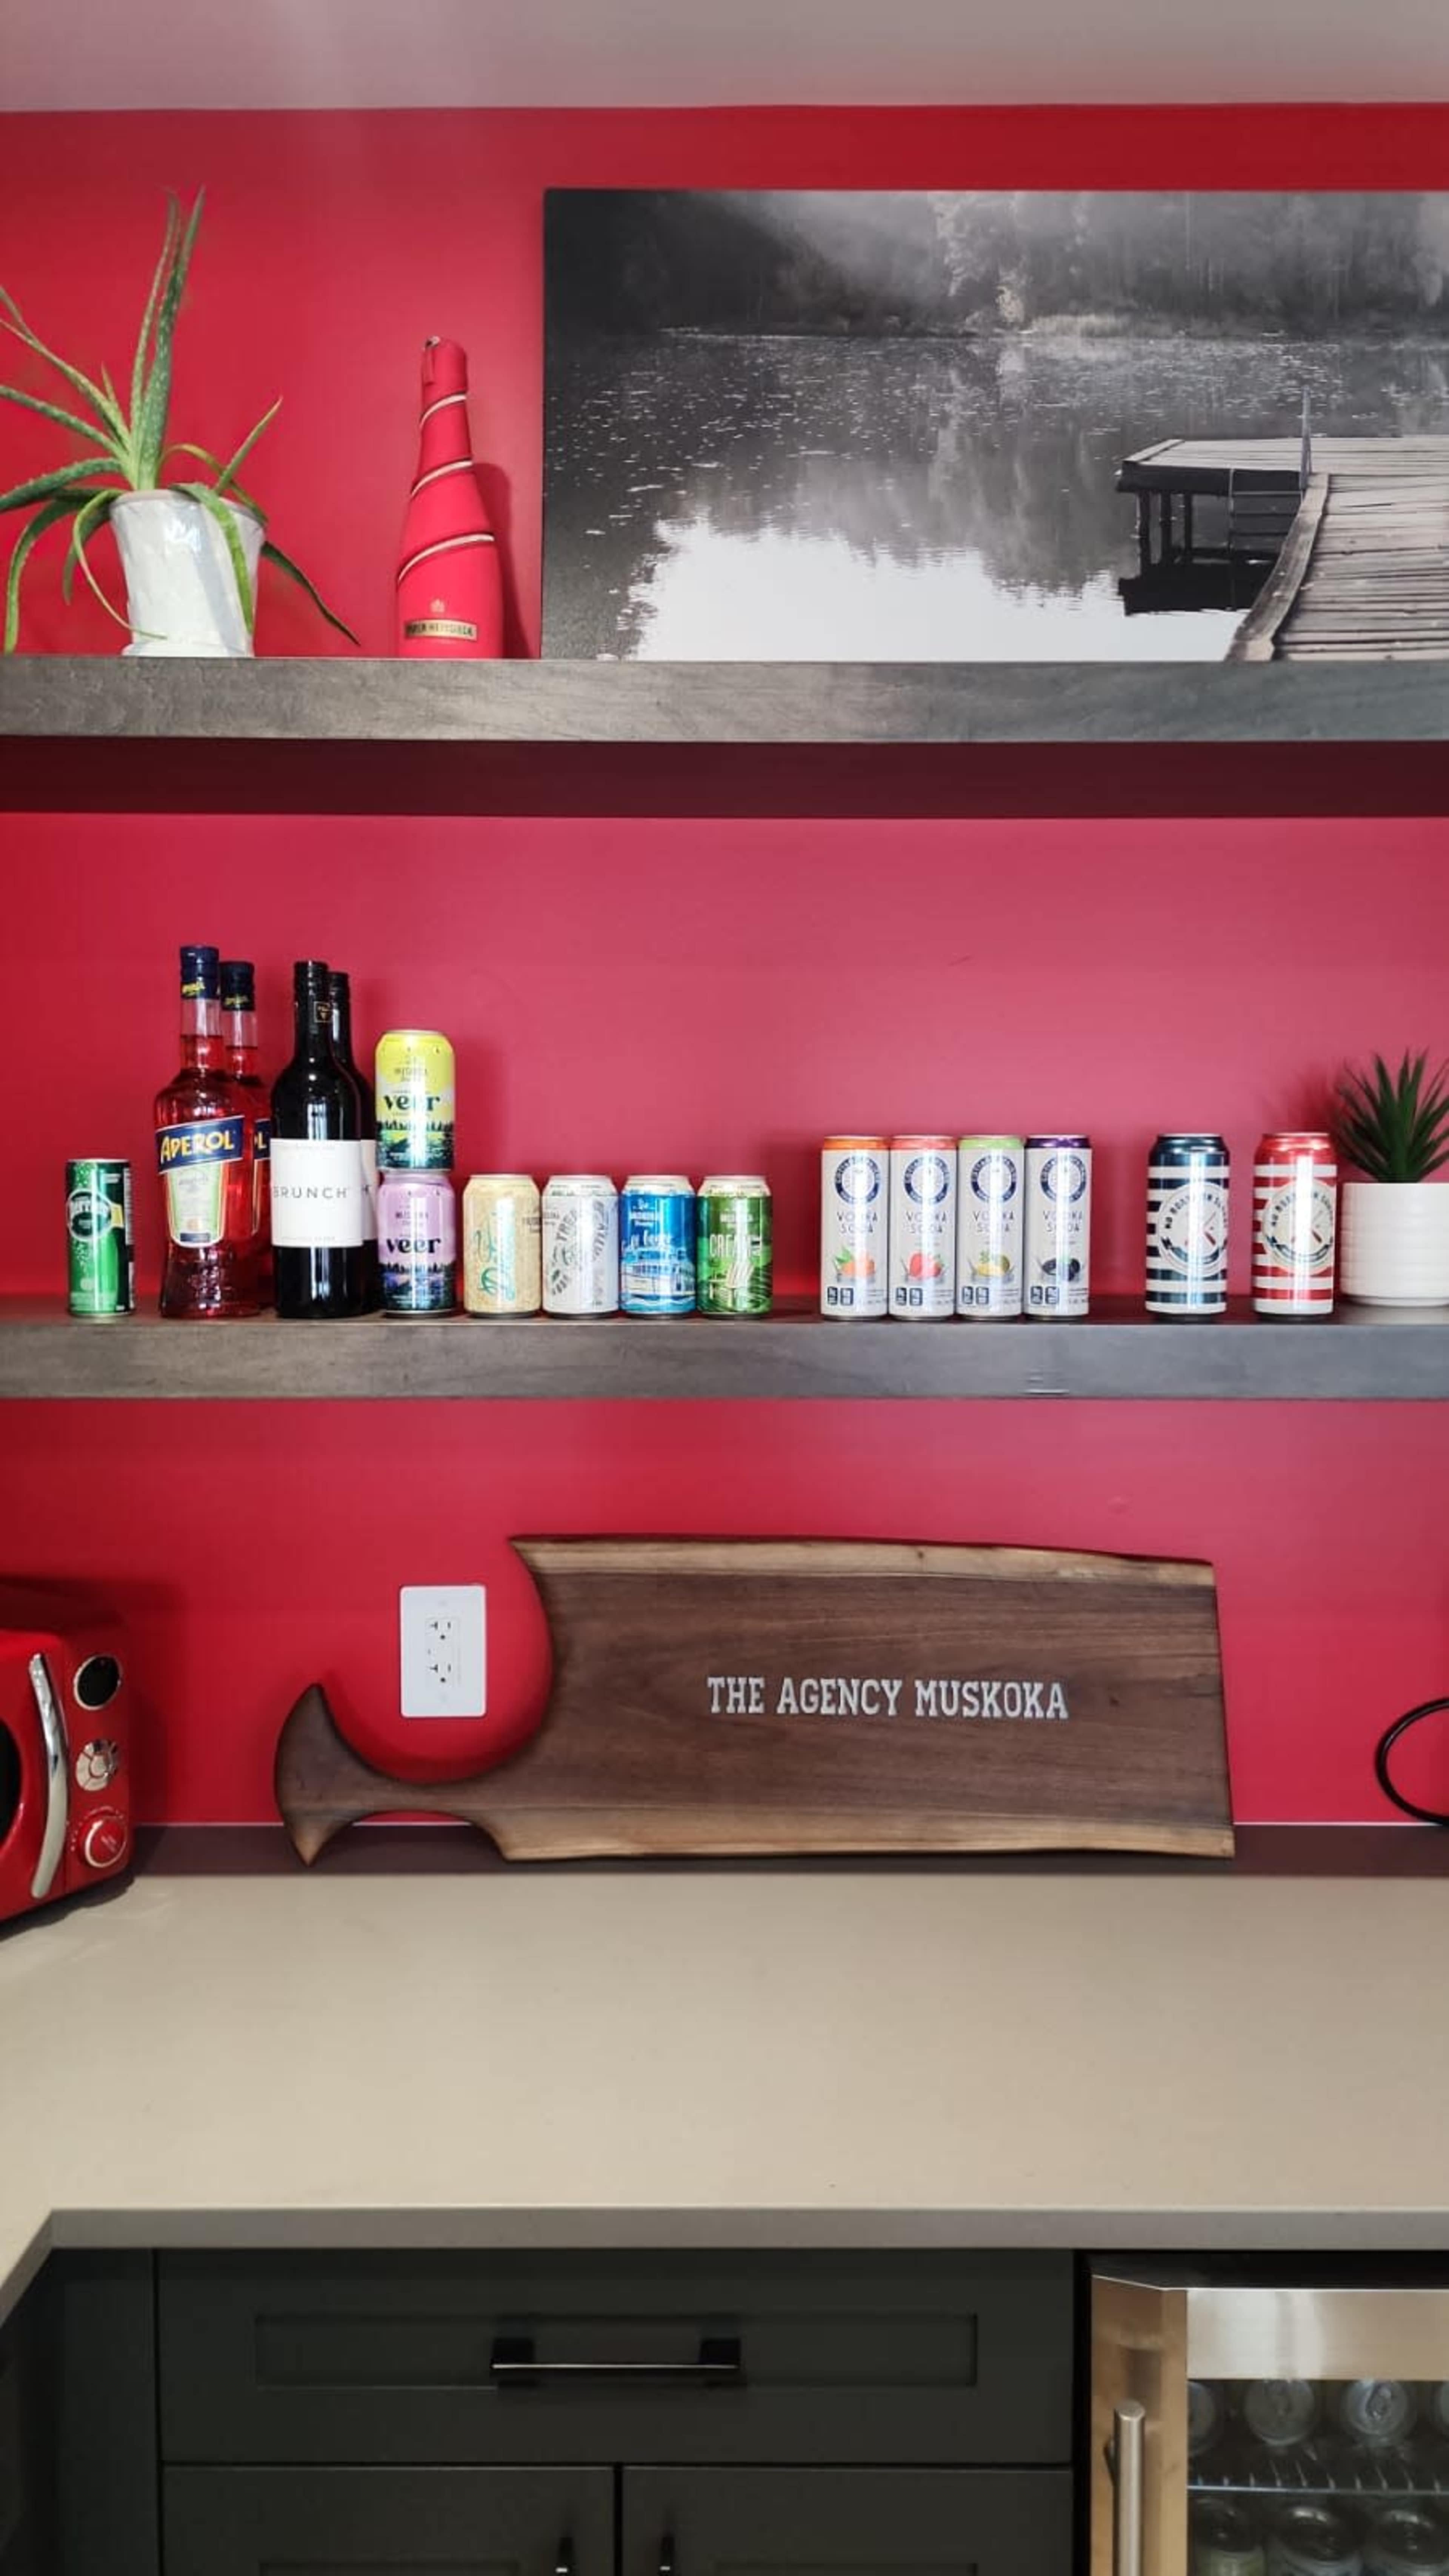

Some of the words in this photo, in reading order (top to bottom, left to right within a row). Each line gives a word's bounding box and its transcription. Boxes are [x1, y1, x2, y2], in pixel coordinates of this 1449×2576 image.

[383, 1094, 440, 1111] ver
[160, 1130, 234, 1164] APEROL
[273, 1186, 346, 1199] BRUNCH
[837, 1211, 878, 1222] VOKA
[906, 1211, 946, 1222] VOKA
[974, 1211, 1014, 1221] VOKA
[1043, 1211, 1083, 1221] VOKA
[840, 1224, 874, 1234] SOA
[977, 1223, 1010, 1233] SOA
[1047, 1223, 1080, 1233] SDA
[386, 1237, 441, 1253] veer
[708, 1676, 765, 1713] THE
[777, 1678, 902, 1716] AGENCY
[915, 1679, 1069, 1719] MUSKOKA
